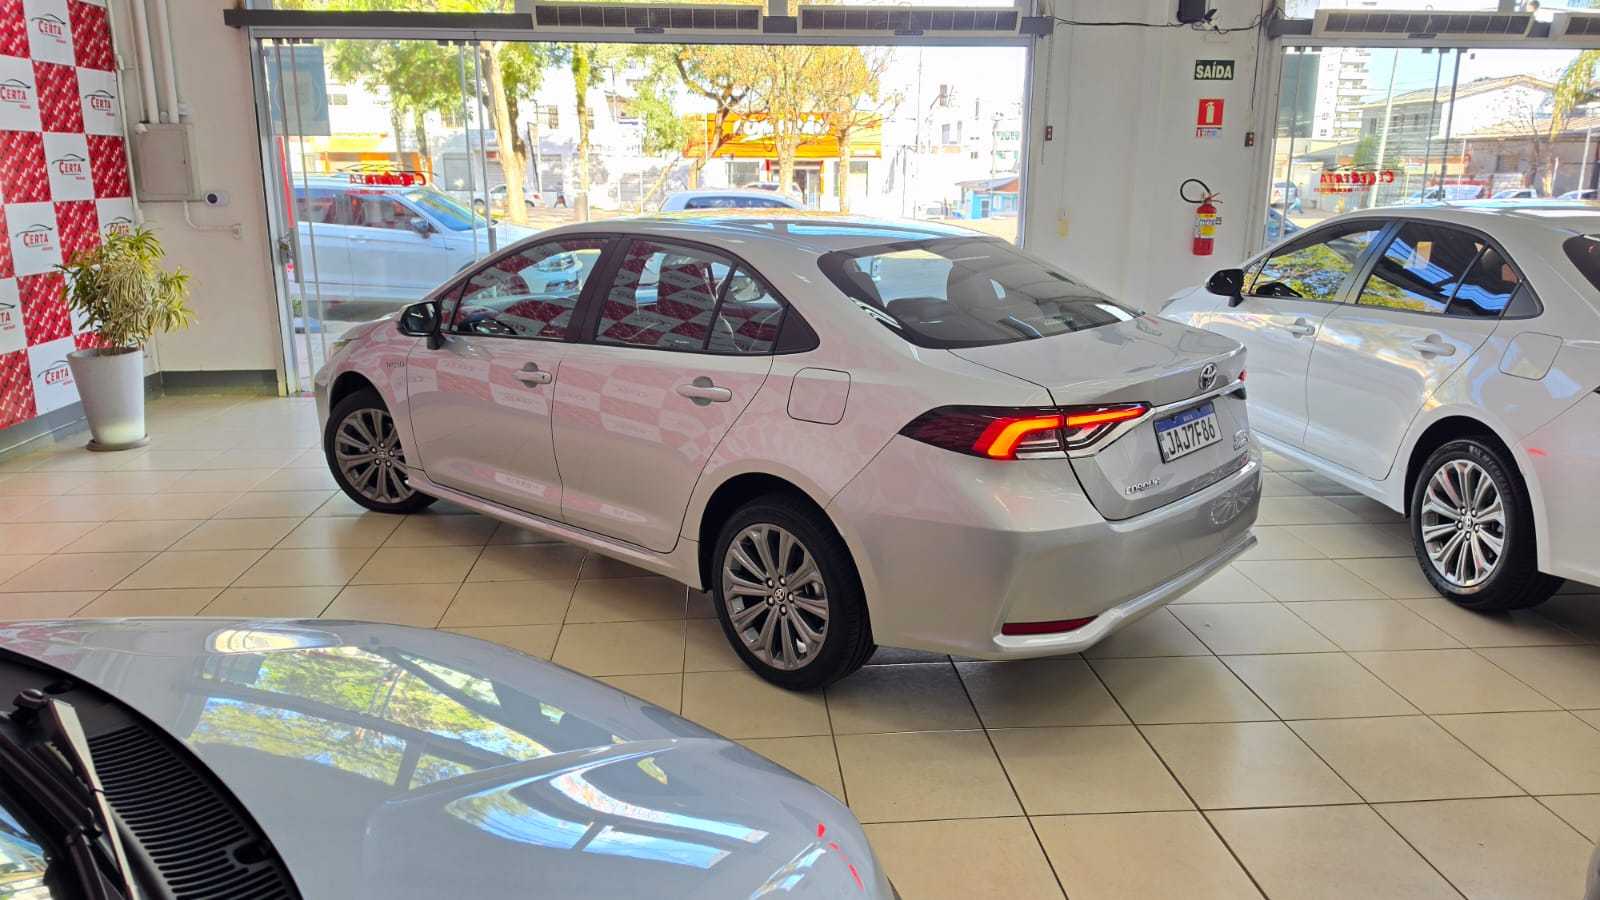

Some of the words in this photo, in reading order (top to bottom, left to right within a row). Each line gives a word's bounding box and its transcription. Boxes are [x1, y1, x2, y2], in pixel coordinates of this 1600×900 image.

[39, 20, 62, 35] CERTA
[1195, 61, 1233, 79] SAÍDA
[0, 86, 26, 101] CERTA
[91, 96, 111, 110] CERTA
[59, 160, 82, 175] CERTA
[24, 232, 48, 247] CERTA
[45, 367, 69, 385] CERTA
[1166, 417, 1216, 455] JAJ7F86
